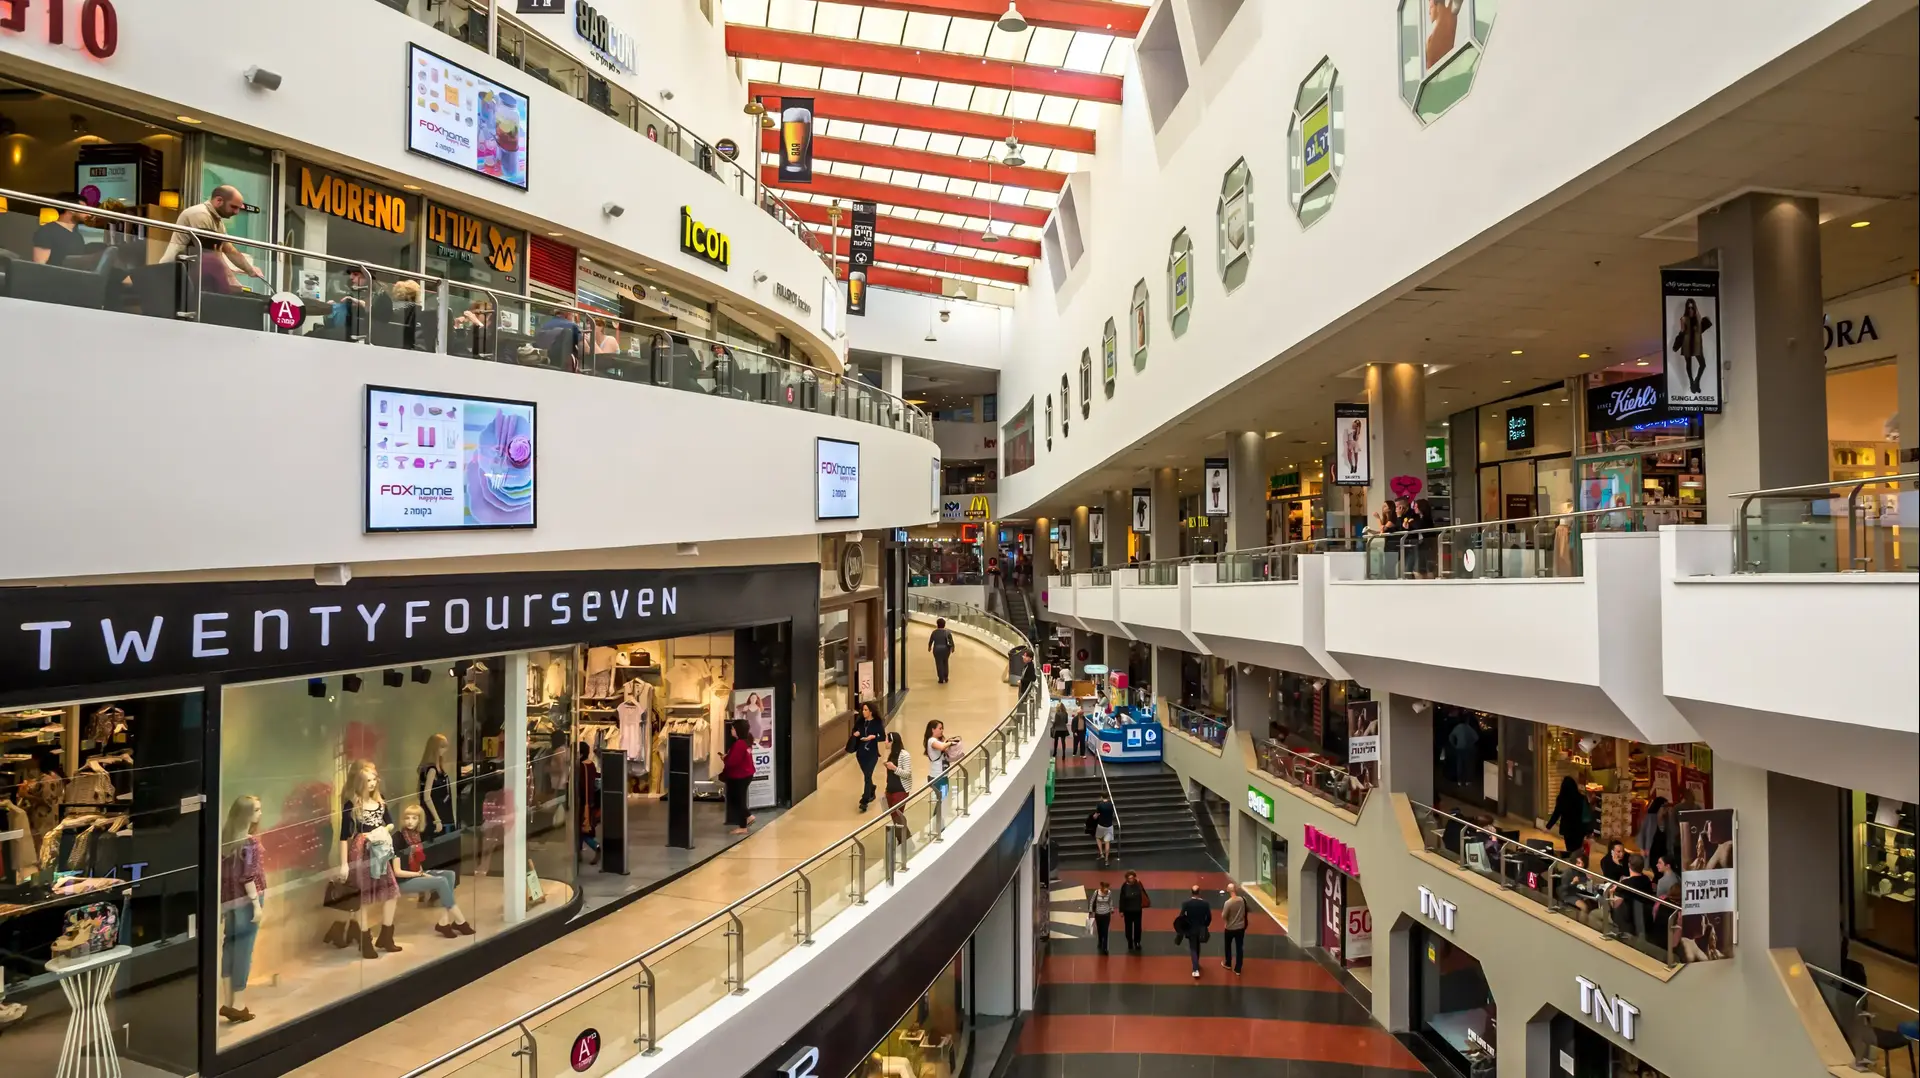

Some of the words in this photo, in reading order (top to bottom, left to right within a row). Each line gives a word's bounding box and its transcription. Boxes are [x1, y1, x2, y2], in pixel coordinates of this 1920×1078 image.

[301, 167, 405, 233] MORENO
[429, 205, 482, 254] מורנו
[684, 205, 731, 266] icon
[854, 229, 872, 237] חיים
[279, 301, 293, 318] A
[1608, 385, 1657, 416] Kiehl's
[821, 461, 856, 476] FOXhome
[380, 484, 452, 496] FOXhome
[410, 508, 432, 517] בקומה
[1351, 745, 1376, 755] חלונות
[756, 755, 770, 765] 50
[1684, 886, 1728, 901] חלונות
[1418, 884, 1457, 931] TNT
[1576, 975, 1640, 1040] TNT
[579, 1038, 590, 1062] A
